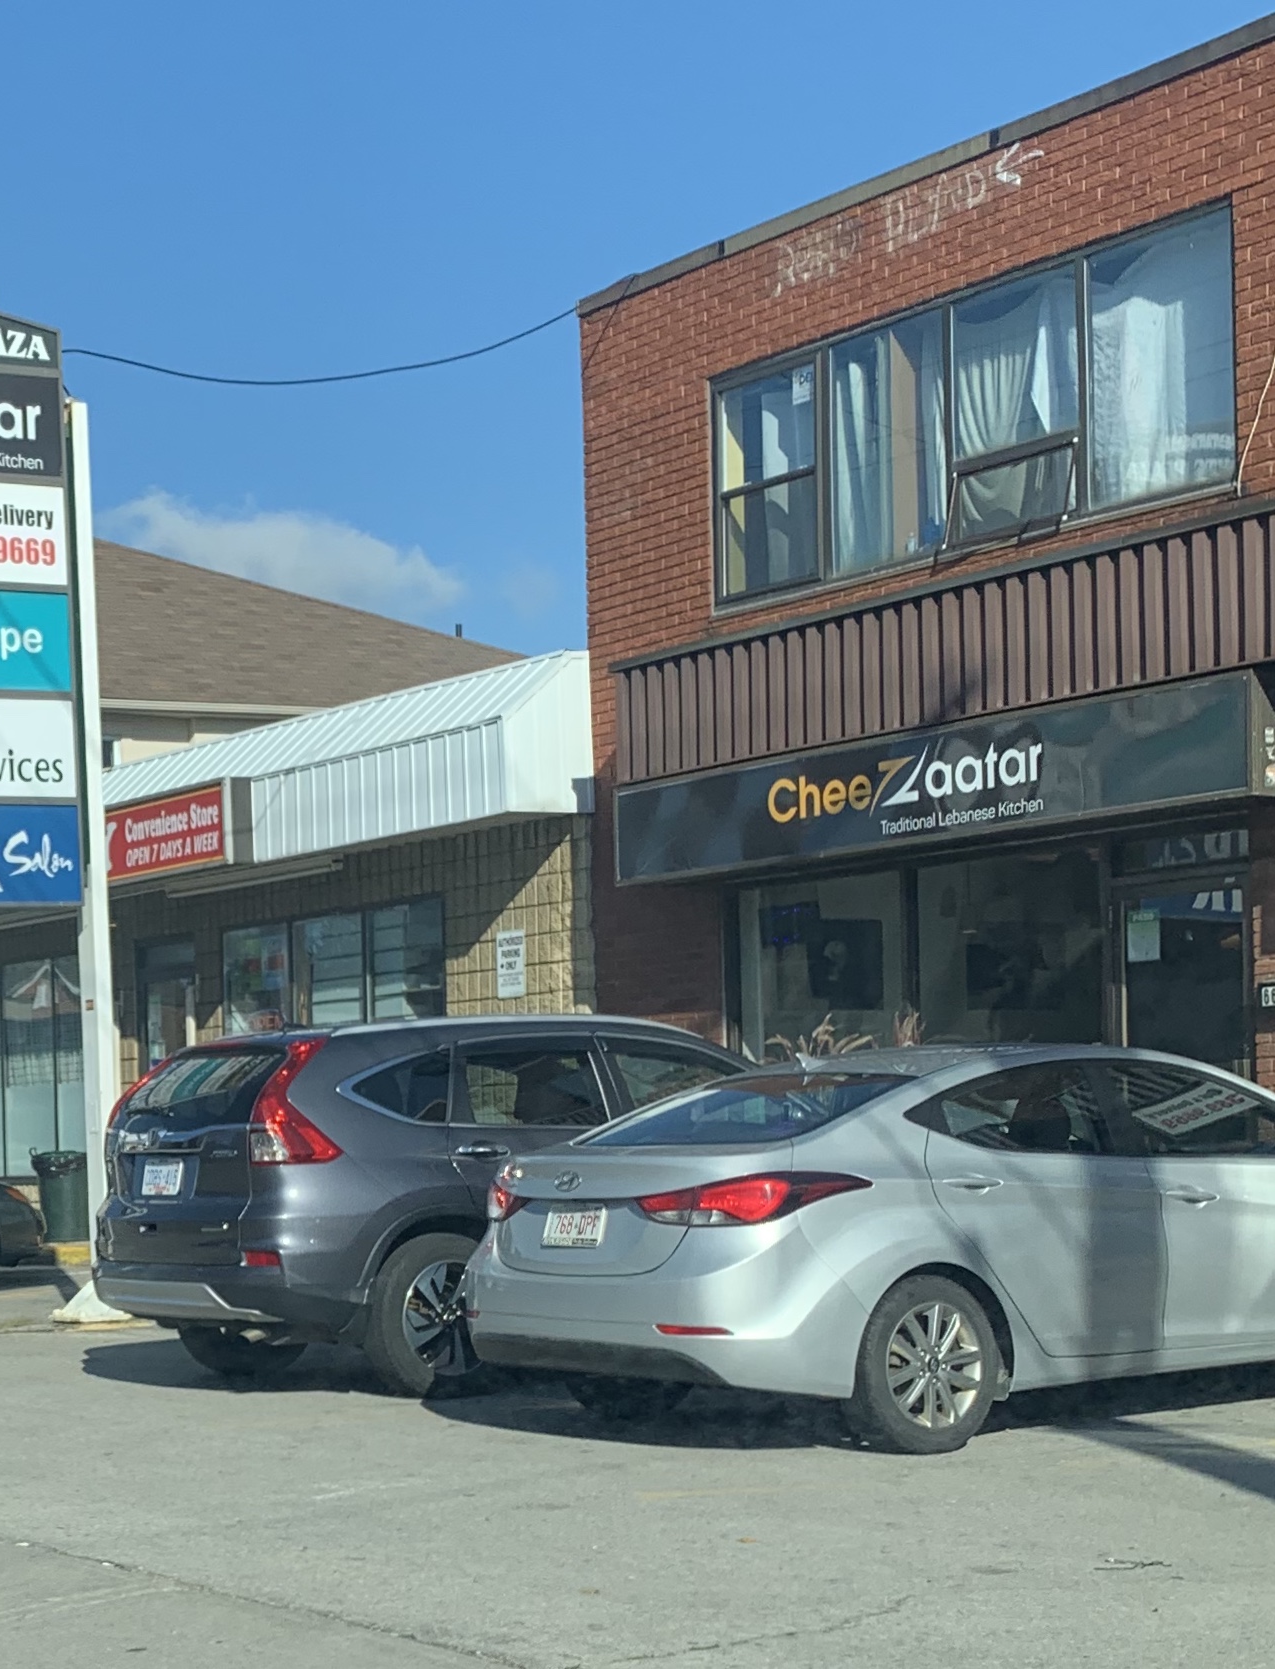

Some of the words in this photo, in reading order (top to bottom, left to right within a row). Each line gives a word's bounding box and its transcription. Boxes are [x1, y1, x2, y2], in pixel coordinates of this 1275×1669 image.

[767, 742, 1043, 823] CheeZaatar
[125, 810, 188, 843] Convenience
[190, 803, 219, 829] Store
[880, 812, 936, 836] Traditional
[938, 806, 996, 827] Lebanese
[998, 797, 1044, 817] Kitchen
[3, 830, 74, 878] Salon
[126, 846, 150, 868] OPEN
[152, 844, 158, 862] 7
[160, 841, 183, 861] DAYS
[184, 838, 193, 856] A
[193, 831, 219, 854] WEEK
